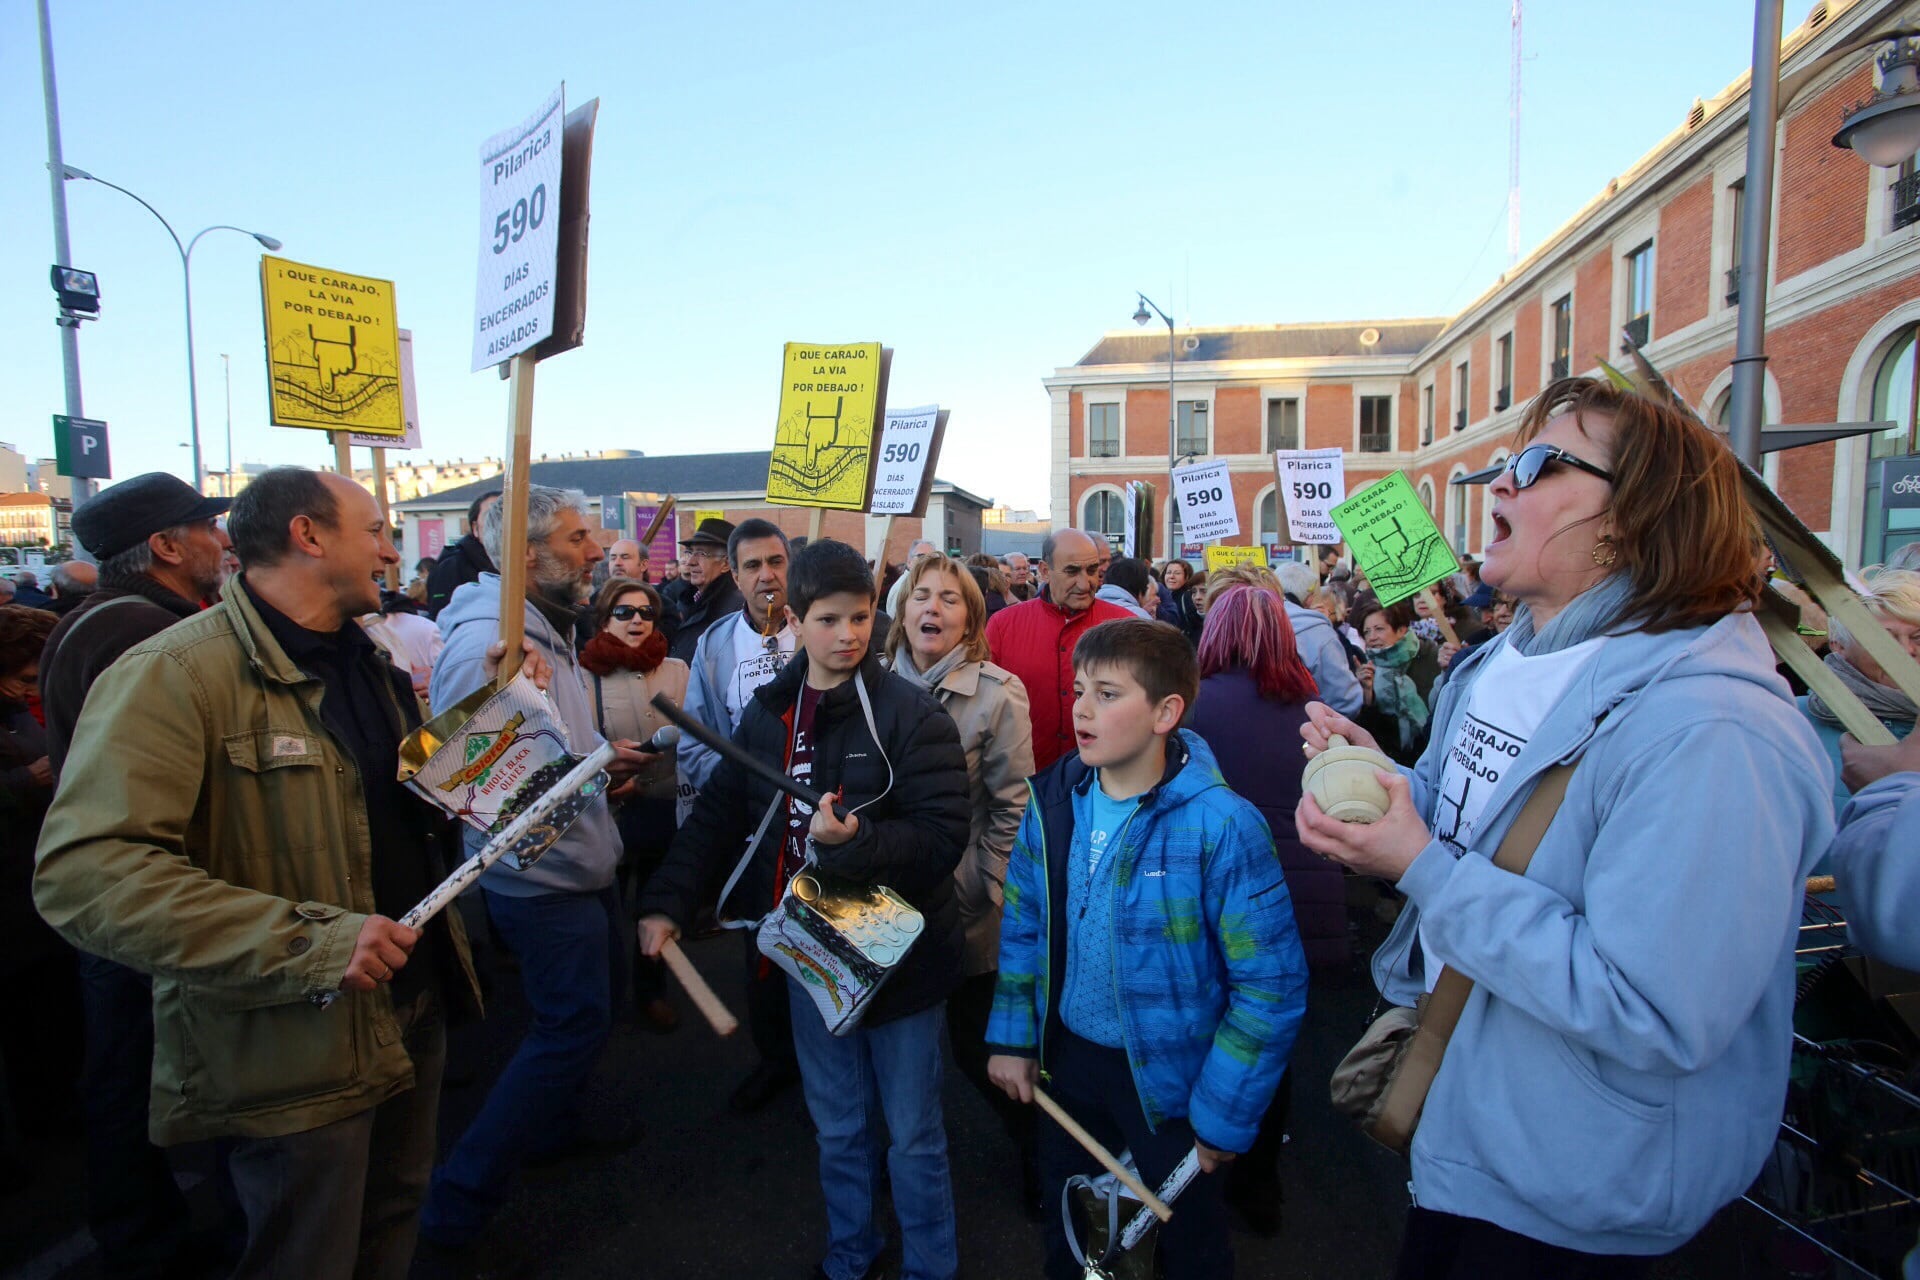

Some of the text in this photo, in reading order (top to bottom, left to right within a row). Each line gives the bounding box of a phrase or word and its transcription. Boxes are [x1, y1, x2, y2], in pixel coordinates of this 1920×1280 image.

[493, 128, 551, 185] Pilarica
[493, 183, 546, 255] 590
[287, 269, 317, 284] QUE
[321, 278, 381, 296] CARAJO,
[309, 290, 354, 305] LA VIA
[480, 280, 549, 332] ENCERRADOS
[284, 301, 313, 314] POR
[318, 307, 372, 325] DEBAJO
[487, 317, 539, 357] AISLADOS
[800, 350, 820, 360] QUE
[824, 350, 868, 360] CARAJO,
[813, 366, 847, 375] LA VIA
[793, 383, 813, 392] POR
[816, 383, 858, 392] DEBAJO
[890, 420, 928, 430] Pilarica
[83, 435, 98, 455] P
[883, 442, 920, 463] 590
[1181, 471, 1220, 484] Pilarica
[873, 487, 914, 496] NCERRADOS
[1186, 487, 1223, 507] 590
[1293, 482, 1332, 499] 590
[1343, 502, 1360, 514] QUE
[1360, 499, 1387, 517] LA VIA
[1186, 518, 1233, 531] ENCERRADOS
[1352, 523, 1369, 535] POR
[1370, 503, 1403, 525] DEBAJO
[1194, 528, 1229, 539] AISLADOS
[481, 746, 531, 796] WHOLE BLACK
[500, 763, 527, 791] OLIVES
